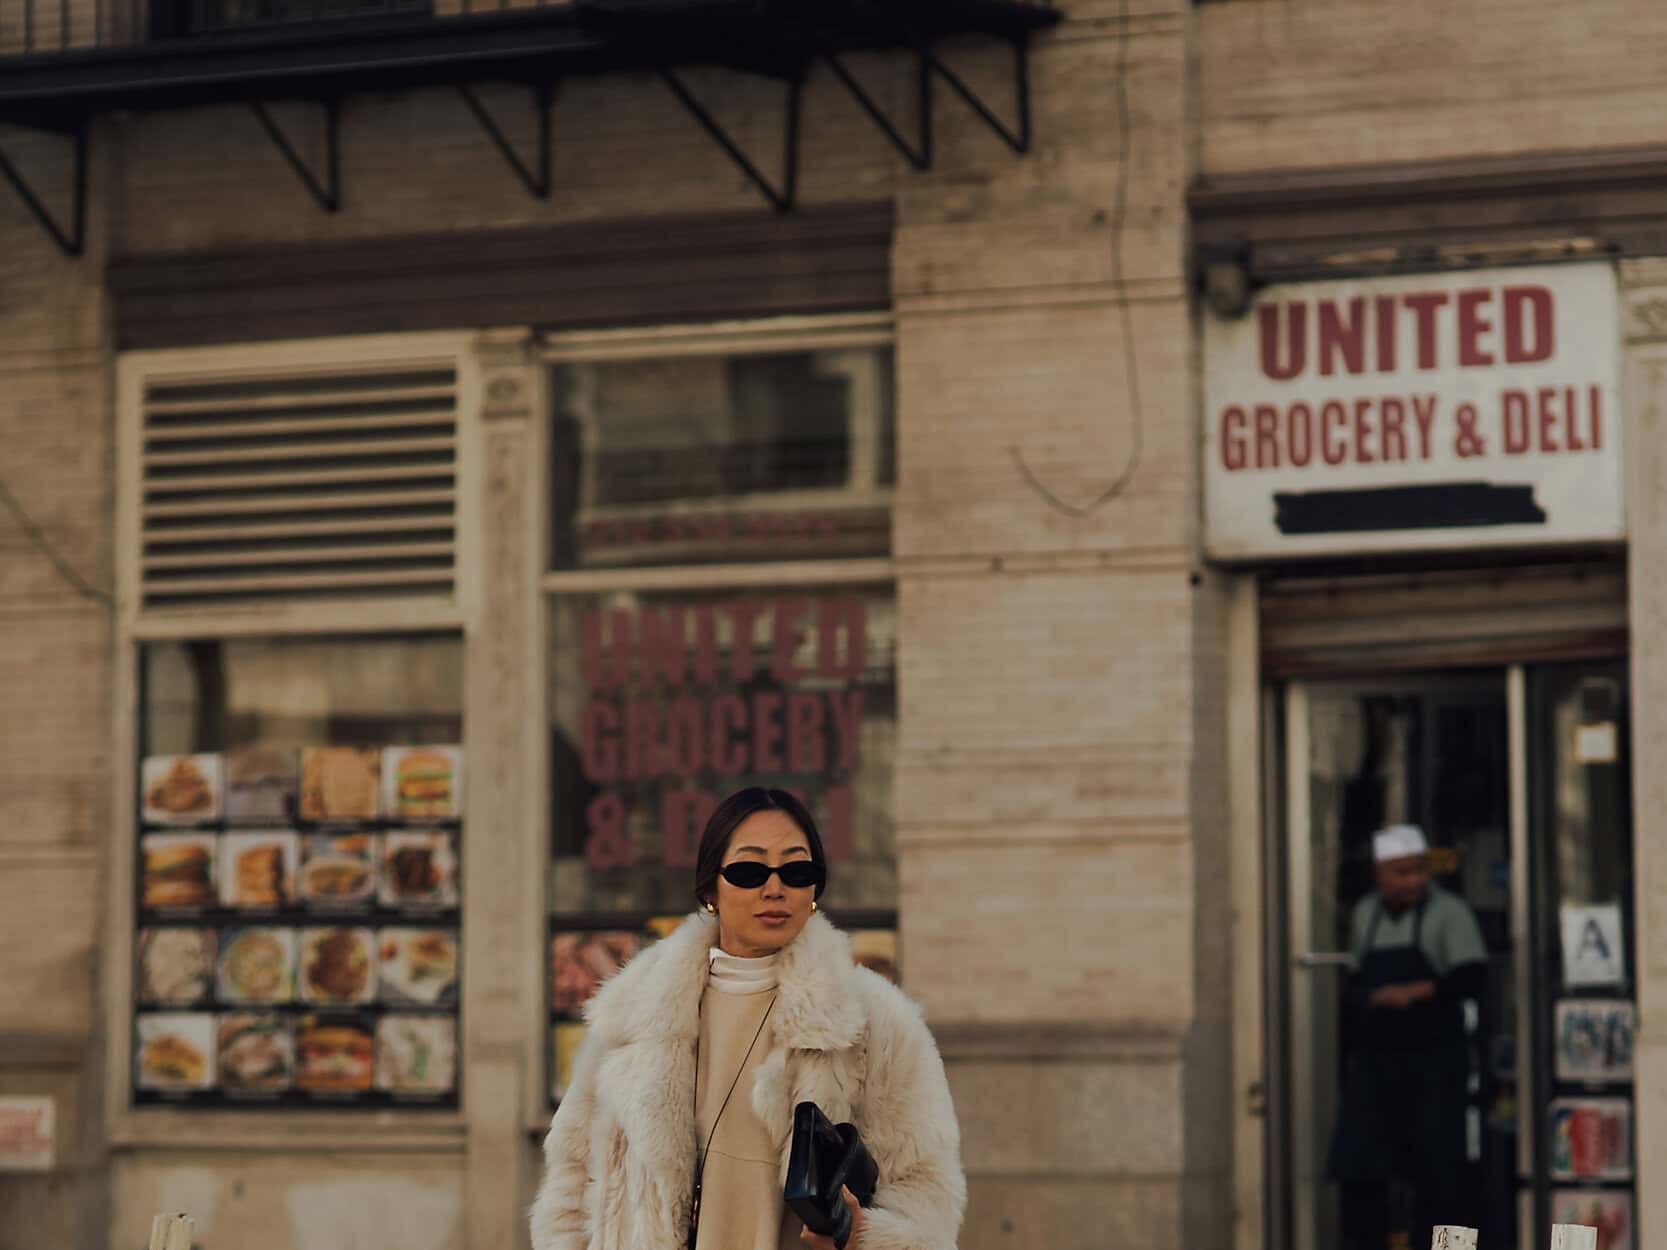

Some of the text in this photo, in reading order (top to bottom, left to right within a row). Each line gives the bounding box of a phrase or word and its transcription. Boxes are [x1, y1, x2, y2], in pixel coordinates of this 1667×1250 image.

[1257, 284, 1555, 380] UNITED
[1221, 384, 1603, 471] GROCERY & DELI
[582, 598, 865, 688] UNITED
[587, 784, 853, 869] & DI
[1577, 918, 1610, 960] A
